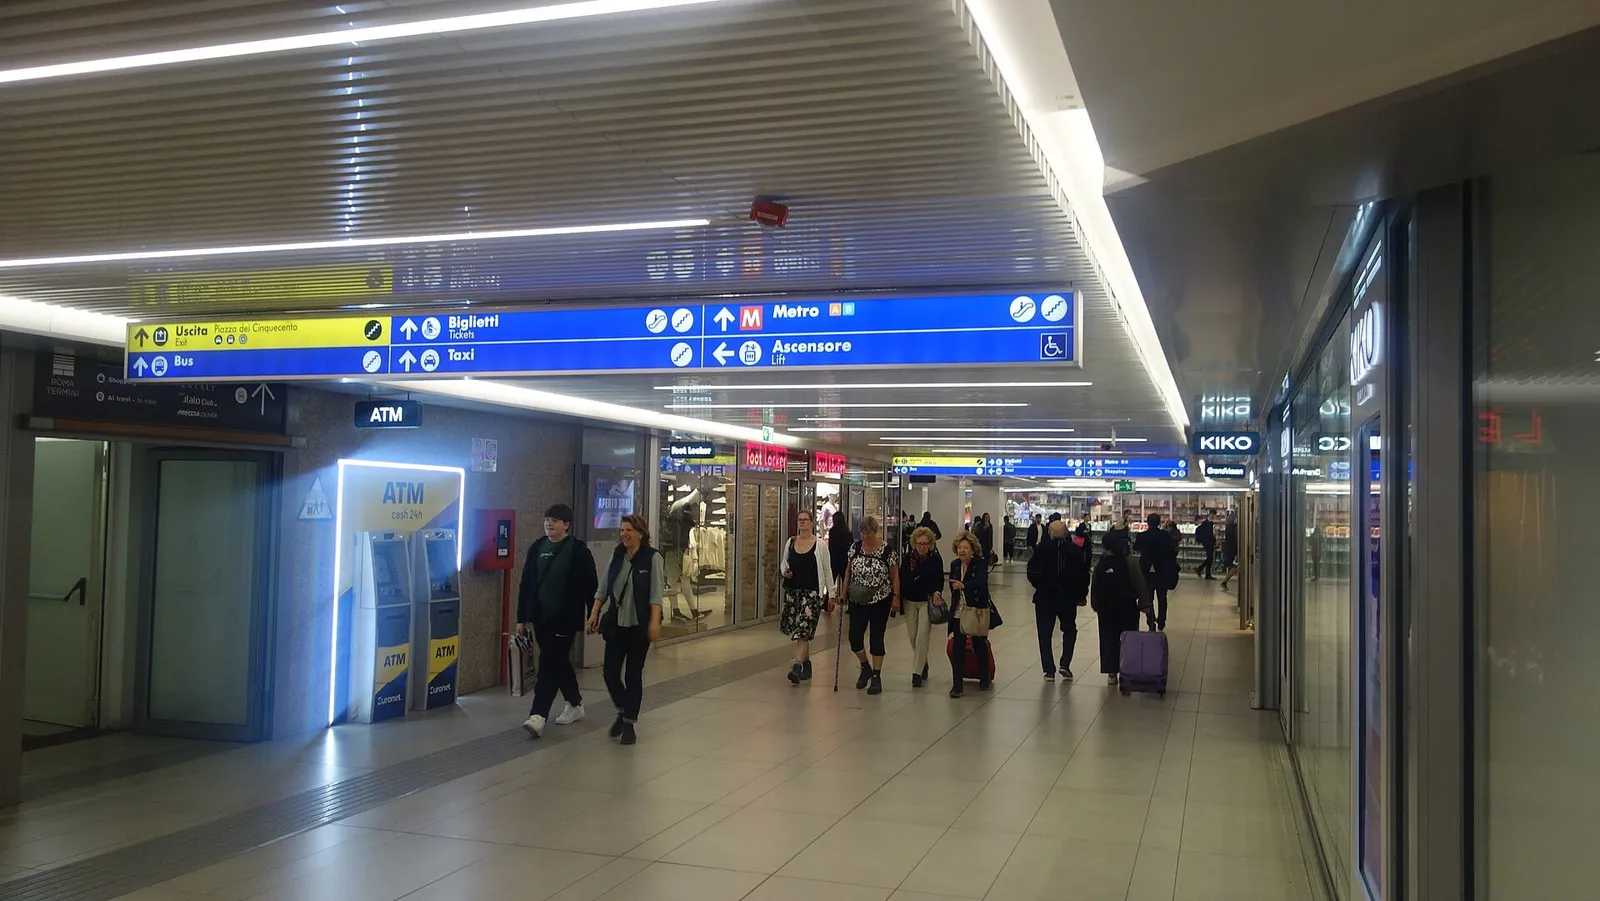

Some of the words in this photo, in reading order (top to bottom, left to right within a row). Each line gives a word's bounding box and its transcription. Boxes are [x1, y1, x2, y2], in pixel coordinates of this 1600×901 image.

[773, 304, 820, 319] Metro
[448, 314, 499, 331] Biglietti
[176, 325, 208, 337] Uscita
[214, 324, 237, 335] Piazza
[239, 324, 251, 333] dei
[252, 322, 299, 335] Cinquecento
[449, 329, 475, 340] Tickets
[175, 337, 188, 347] Exit
[771, 339, 852, 354] Ascensore
[448, 347, 475, 361] Taxi
[771, 353, 786, 366] Lift
[174, 355, 194, 367] Bus
[50, 377, 75, 387] ROMA
[46, 386, 80, 397] TERMINI
[369, 406, 403, 423] ATM
[1200, 436, 1252, 451] KIKO
[671, 446, 687, 455] Foot
[688, 446, 712, 455] Locker
[382, 481, 425, 505] ATM
[598, 497, 618, 509] APERTO
[391, 509, 409, 520] cash
[409, 509, 423, 520] 24h
[435, 644, 455, 659] ATM
[383, 652, 406, 668] ATM
[429, 683, 452, 695] Euronet
[377, 694, 402, 706] Euronet
